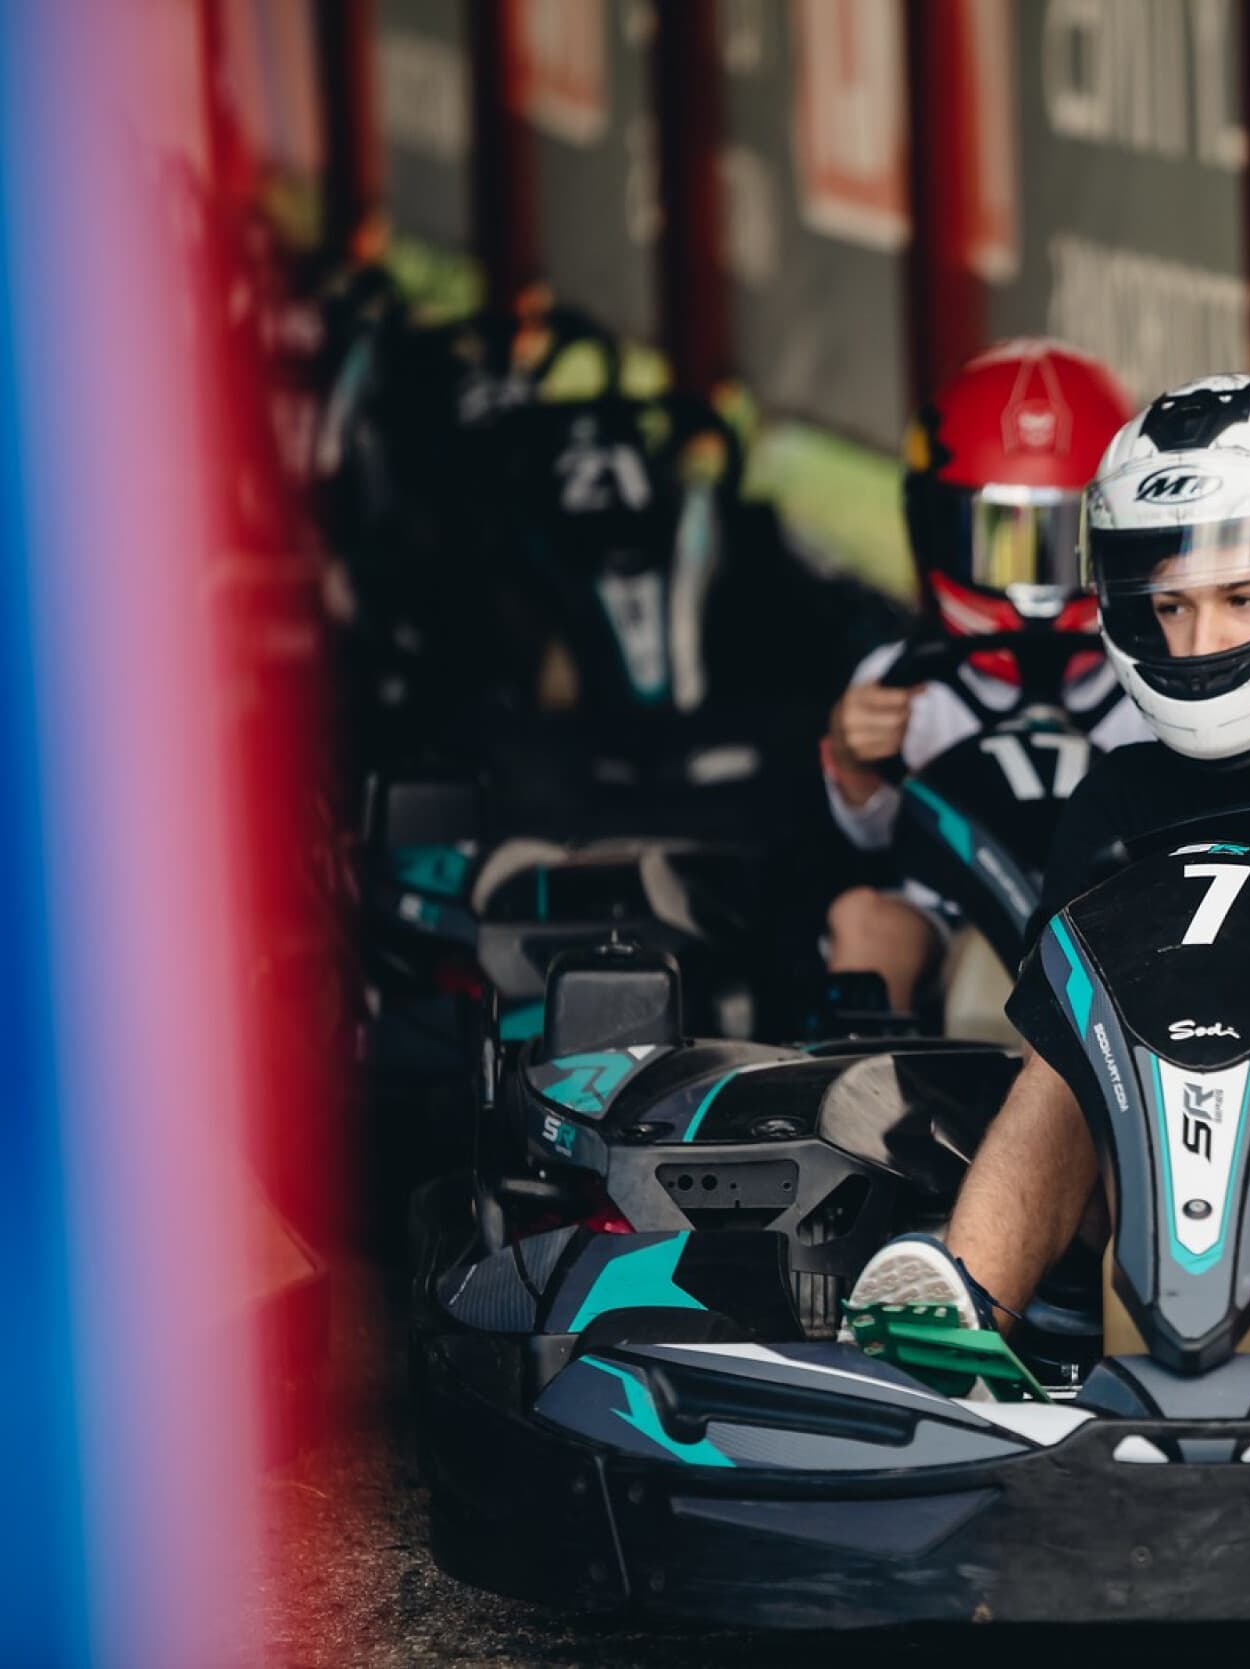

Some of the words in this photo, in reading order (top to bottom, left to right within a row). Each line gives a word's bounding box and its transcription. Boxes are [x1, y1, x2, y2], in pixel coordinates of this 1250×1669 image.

[979, 734, 1089, 800] 17
[1168, 1019, 1240, 1040] Sodi
[542, 1114, 576, 1150] SR
[1182, 1082, 1214, 1163] SR
